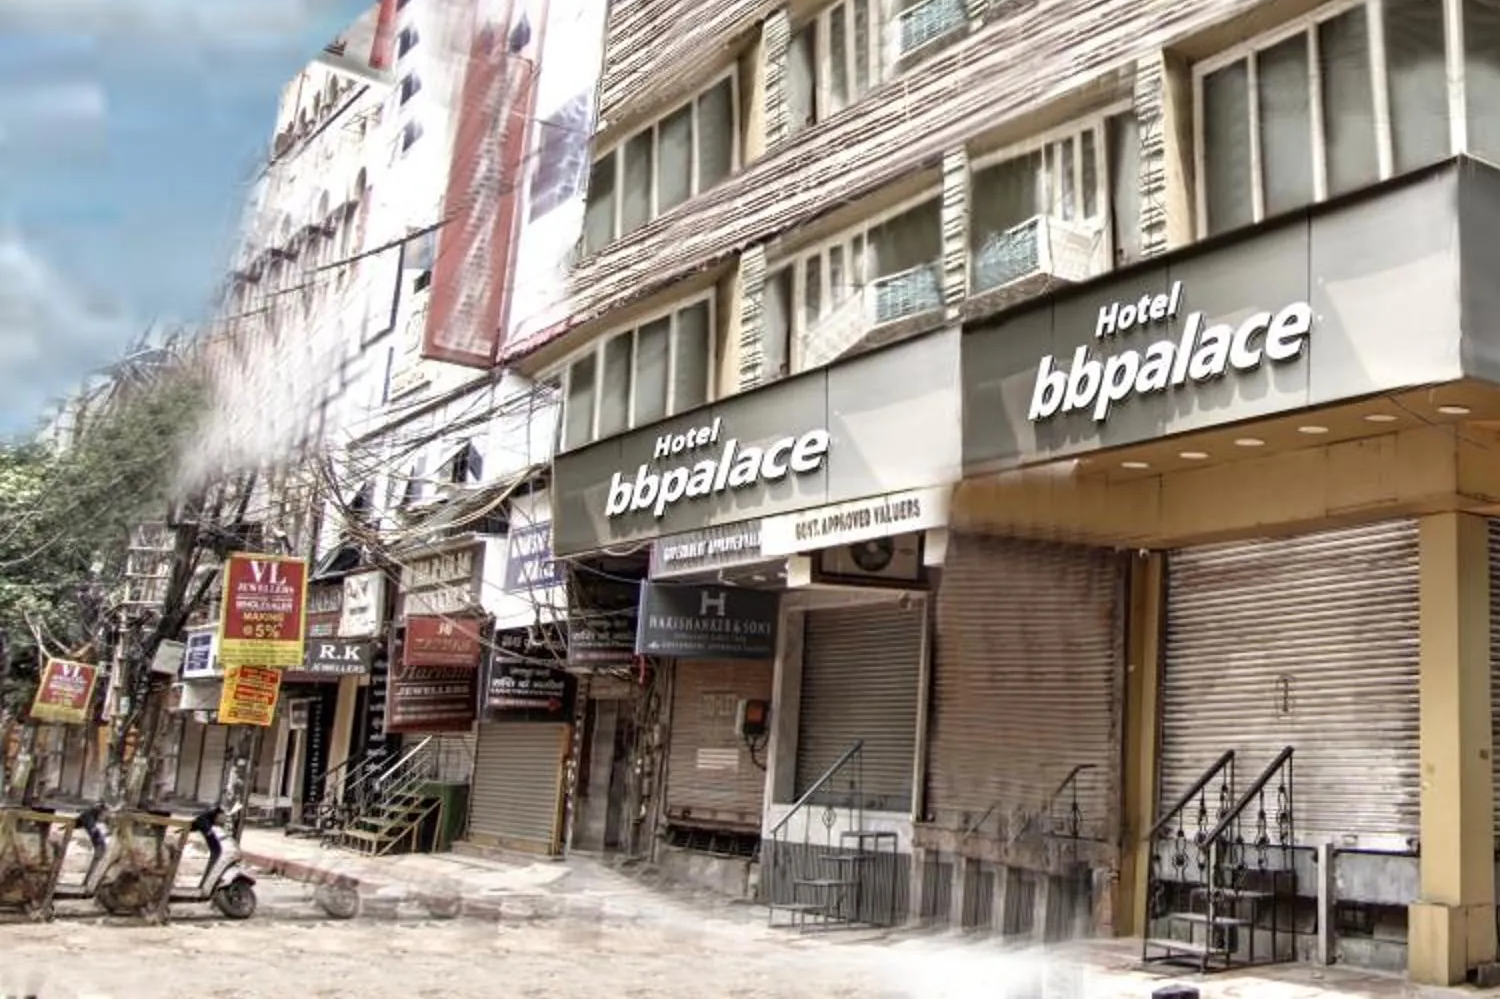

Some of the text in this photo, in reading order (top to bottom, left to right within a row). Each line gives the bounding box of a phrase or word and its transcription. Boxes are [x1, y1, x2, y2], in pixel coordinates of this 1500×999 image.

[1095, 280, 1182, 337] Hotel
[1028, 301, 1312, 421] bbpalace
[653, 416, 721, 459] Hotel
[605, 428, 830, 518] bbpalace
[821, 507, 871, 536] APPROVED
[873, 498, 921, 526] VALUERS
[249, 560, 287, 585] VL
[700, 590, 726, 617] H
[311, 662, 366, 674] JEWELLERS
[319, 644, 361, 660] R.K
[398, 685, 469, 696] JEWELLERS
